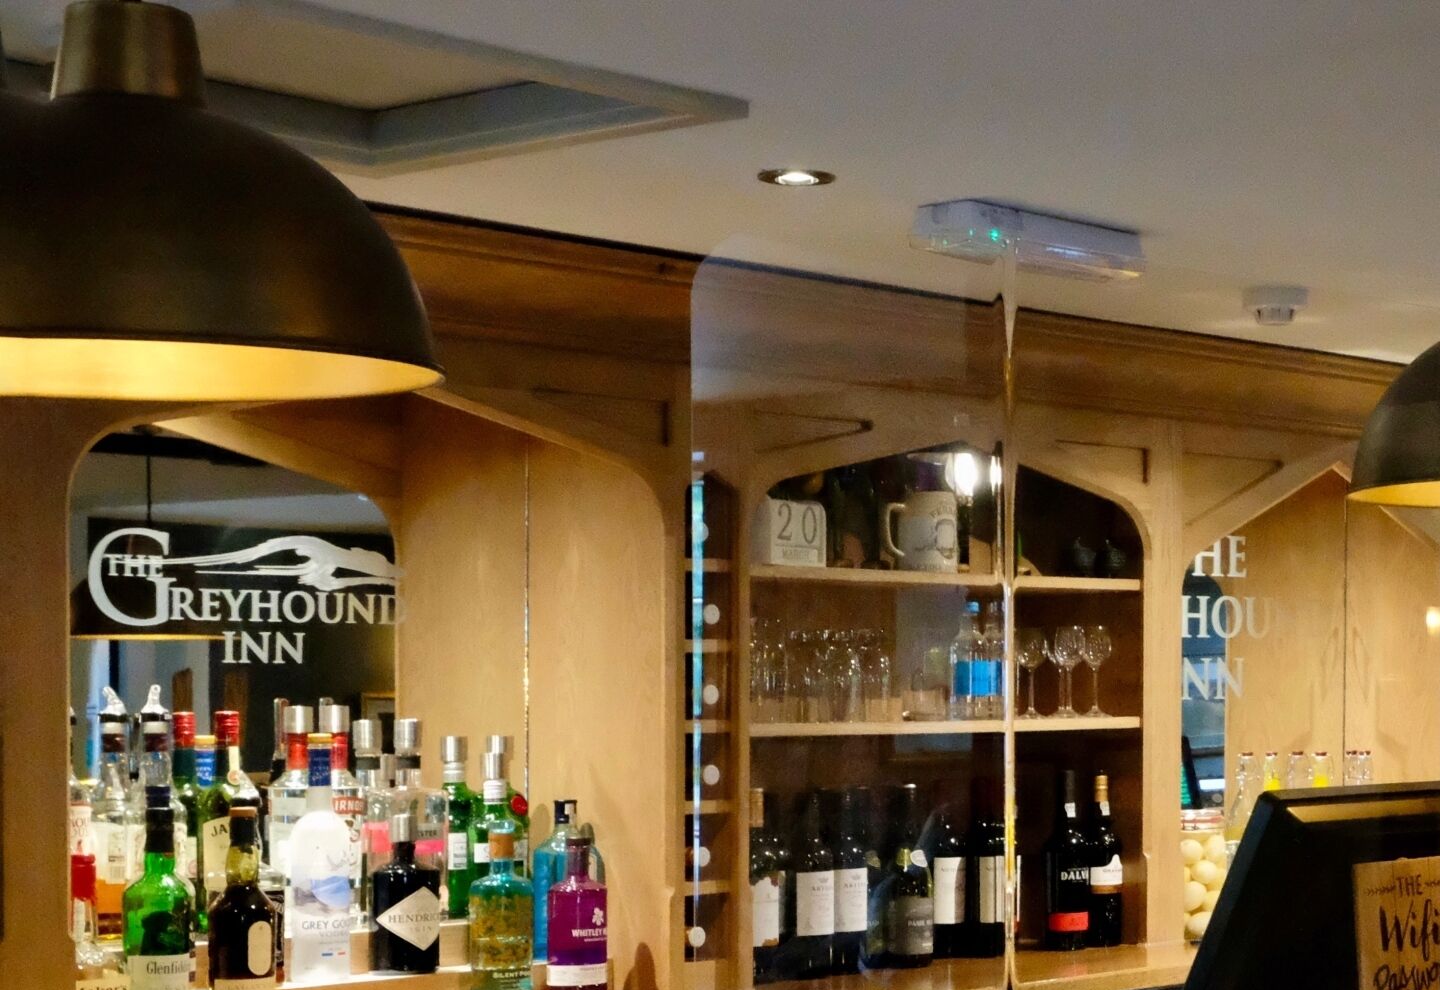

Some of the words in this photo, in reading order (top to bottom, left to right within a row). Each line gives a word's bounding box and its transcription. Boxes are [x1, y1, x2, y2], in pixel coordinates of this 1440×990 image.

[101, 553, 165, 578] THE
[220, 630, 306, 665] INN
[1396, 874, 1424, 897] THE
